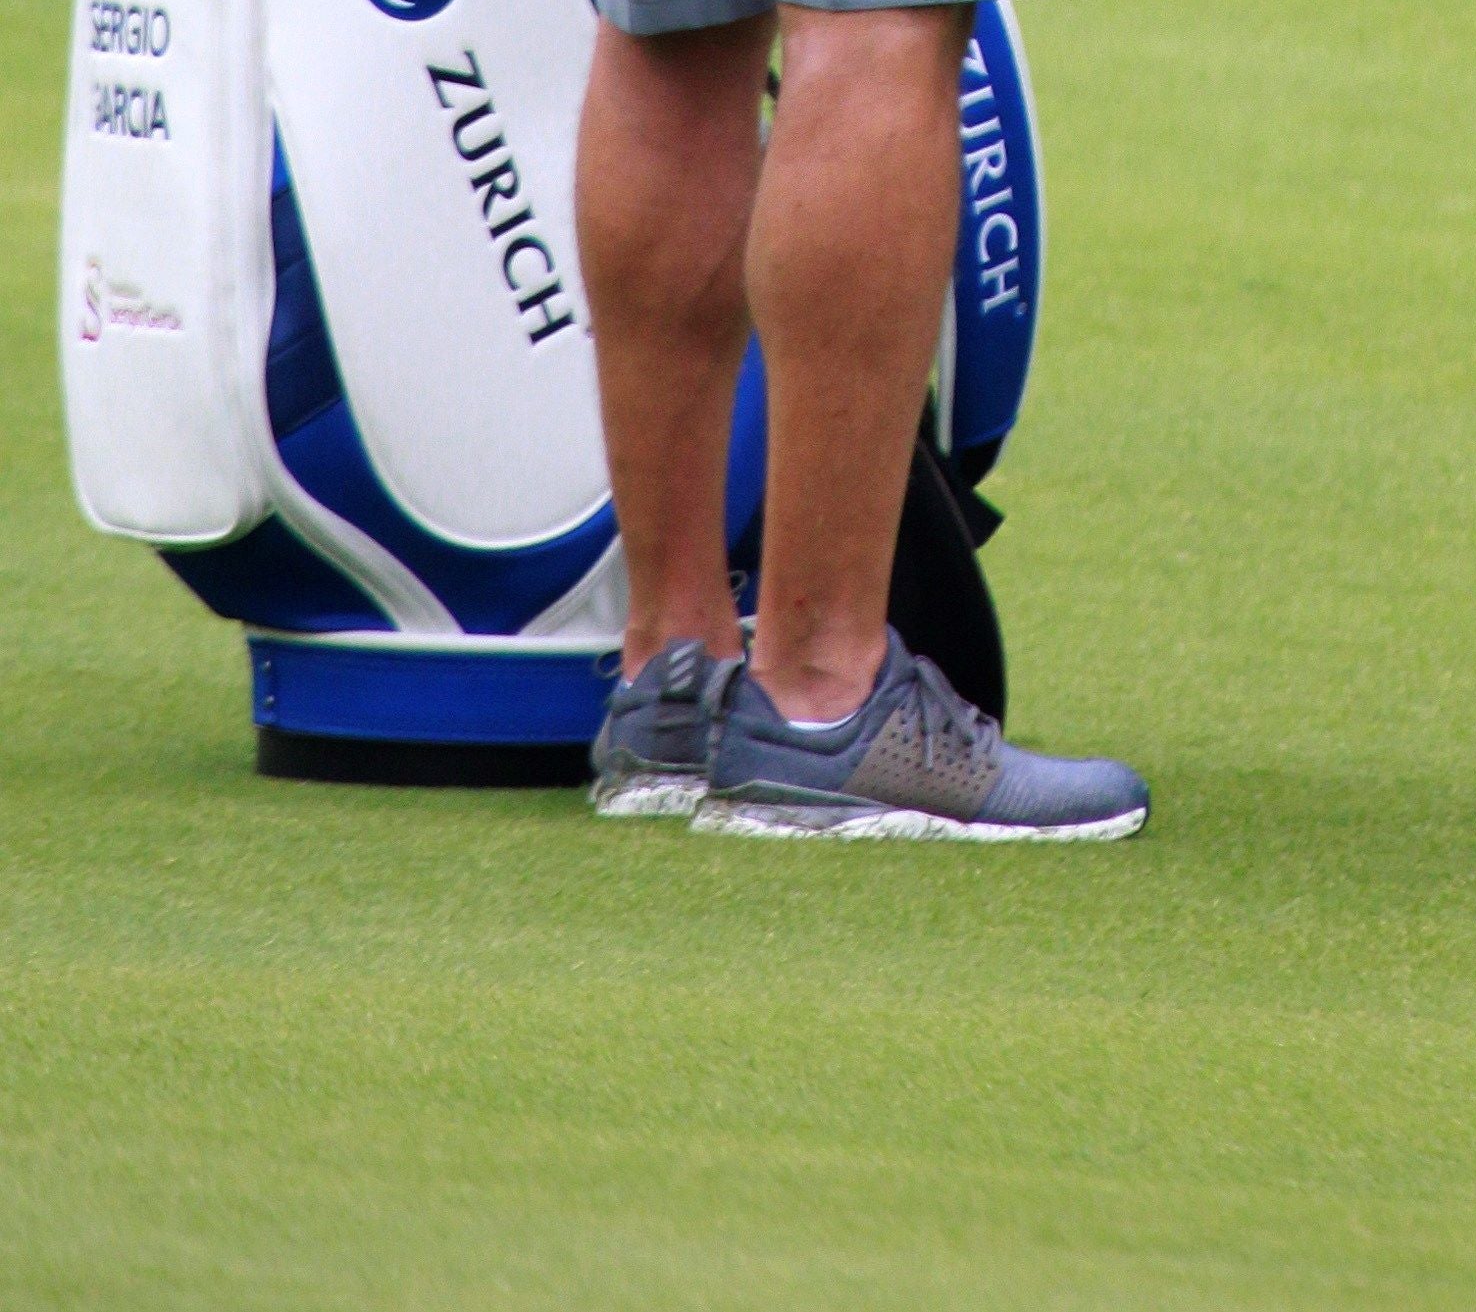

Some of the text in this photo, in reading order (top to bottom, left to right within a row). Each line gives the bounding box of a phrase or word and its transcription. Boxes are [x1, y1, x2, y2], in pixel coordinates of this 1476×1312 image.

[90, 0, 171, 58] SERGIO
[92, 80, 171, 141] ARCIA
[425, 49, 577, 345] ZURICH
